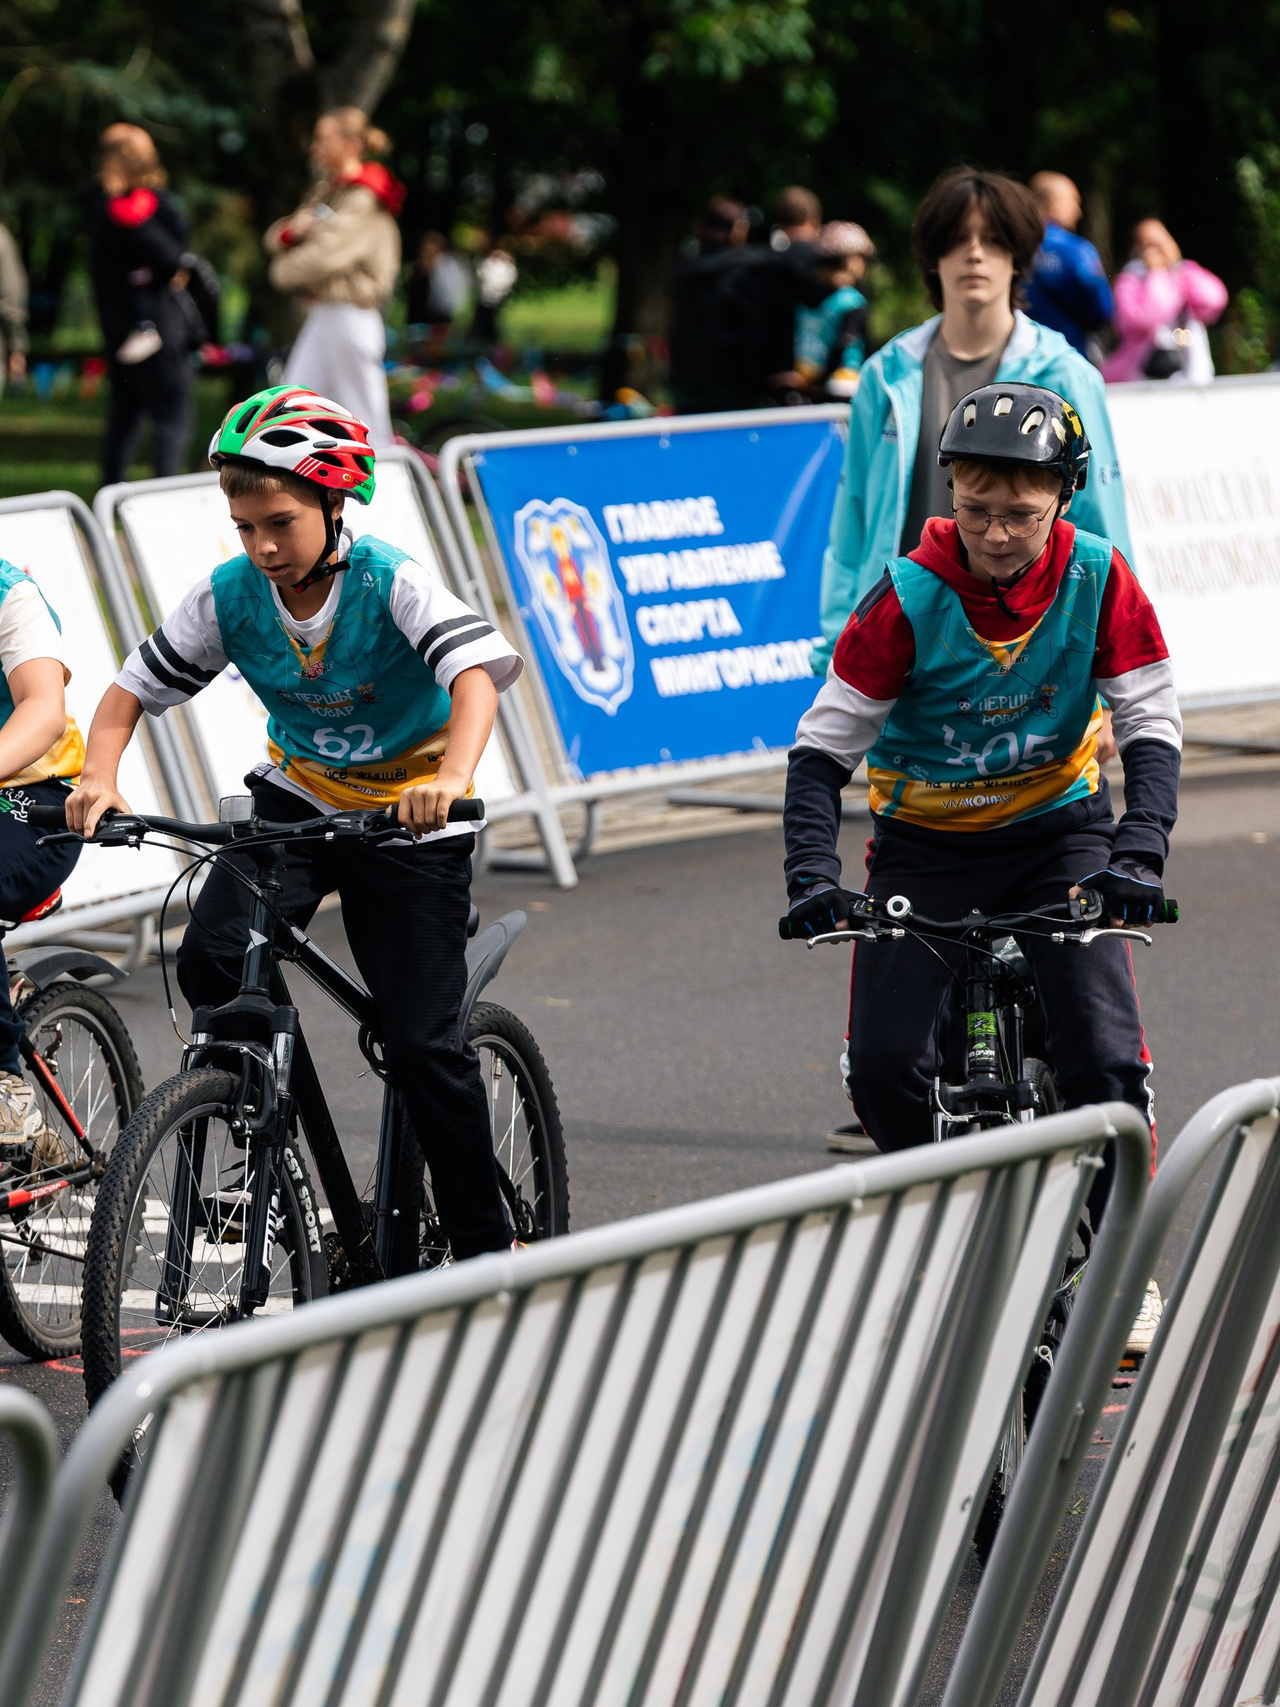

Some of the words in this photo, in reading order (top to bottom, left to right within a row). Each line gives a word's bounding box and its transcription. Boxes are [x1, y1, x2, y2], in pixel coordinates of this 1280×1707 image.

[602, 495, 725, 545] ГЛАВНОЕ
[617, 540, 786, 596] УПРАВЛЕНИЕ
[635, 597, 743, 647] СПОРТА
[294, 689, 354, 705] ПЕРШЫ
[309, 705, 355, 718] РОВАР
[981, 706, 1030, 727] РОВАР
[312, 724, 384, 762] 62
[942, 724, 1059, 777] 405
[30, 1183, 62, 1199] Racer
[283, 1147, 304, 1181] CST
[298, 1185, 322, 1253] SPORT
